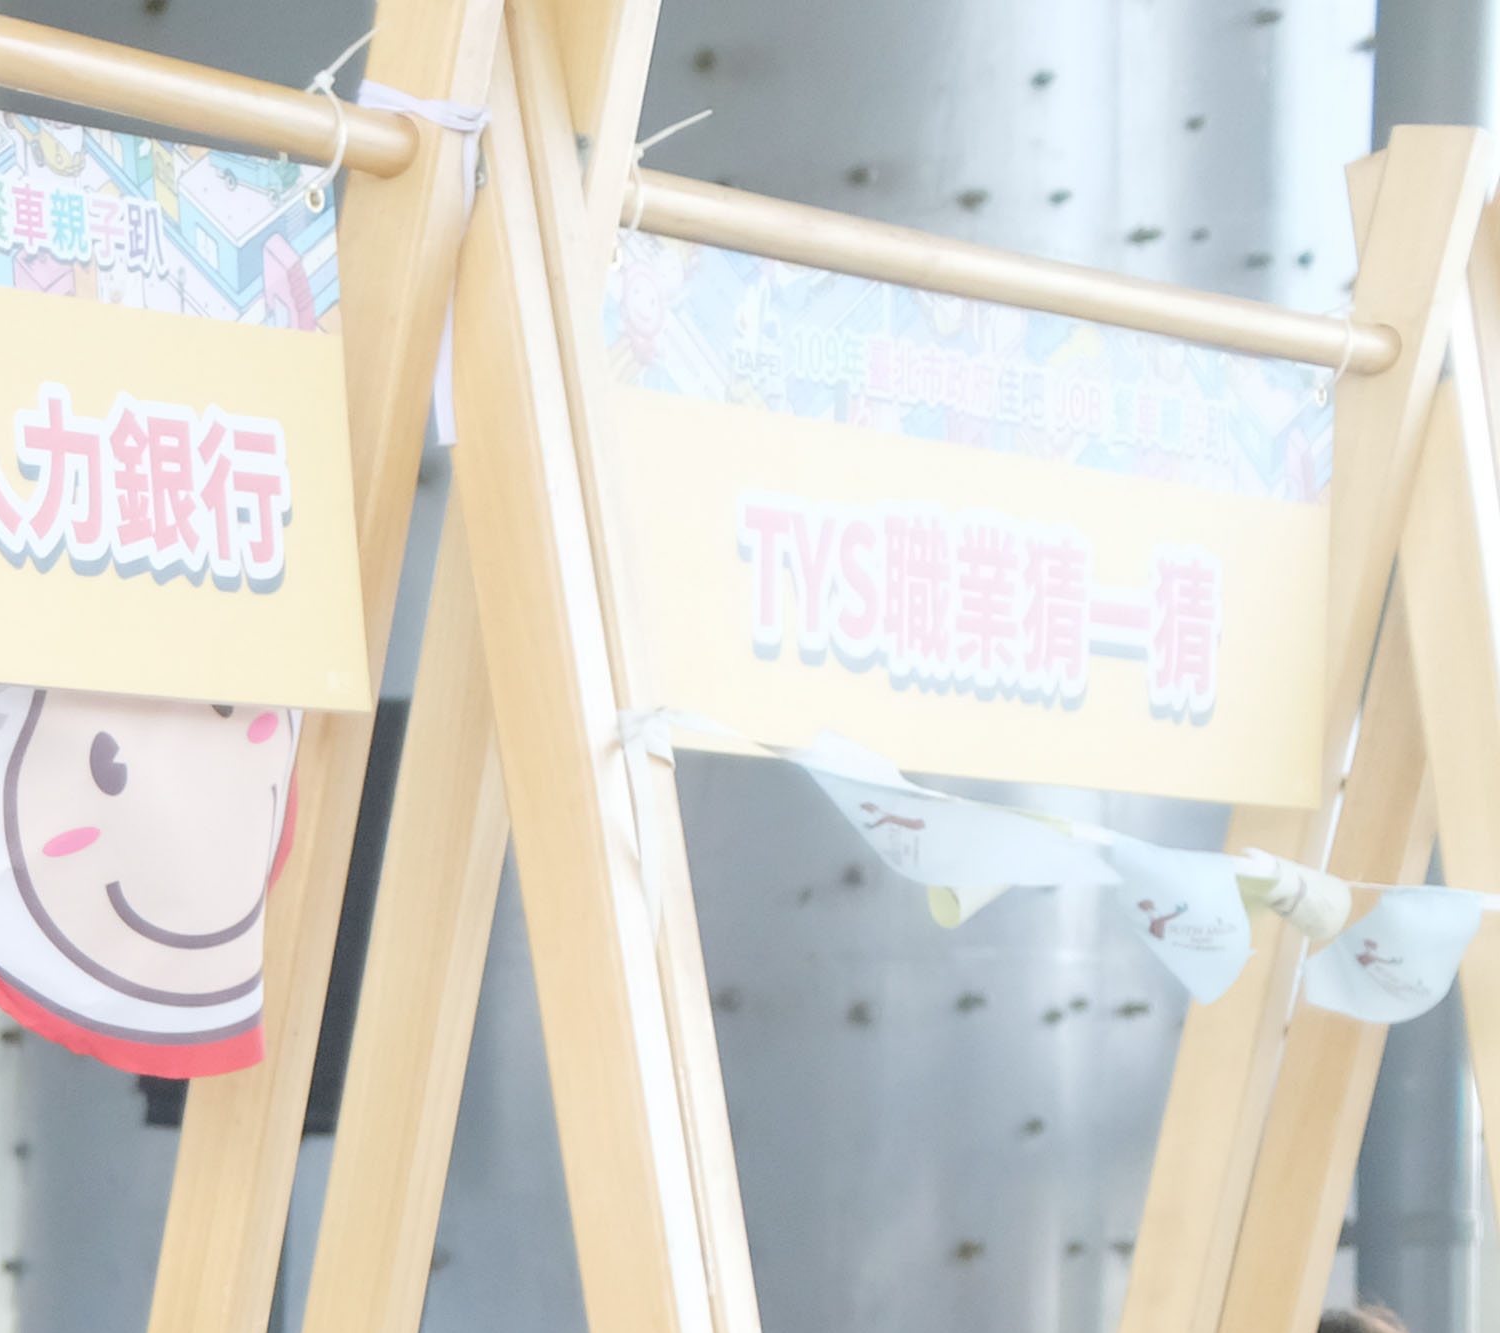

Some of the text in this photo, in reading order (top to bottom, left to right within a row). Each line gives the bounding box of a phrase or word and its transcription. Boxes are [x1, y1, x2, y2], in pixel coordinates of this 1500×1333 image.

[741, 500, 1220, 710] TYS職業猜一猜
